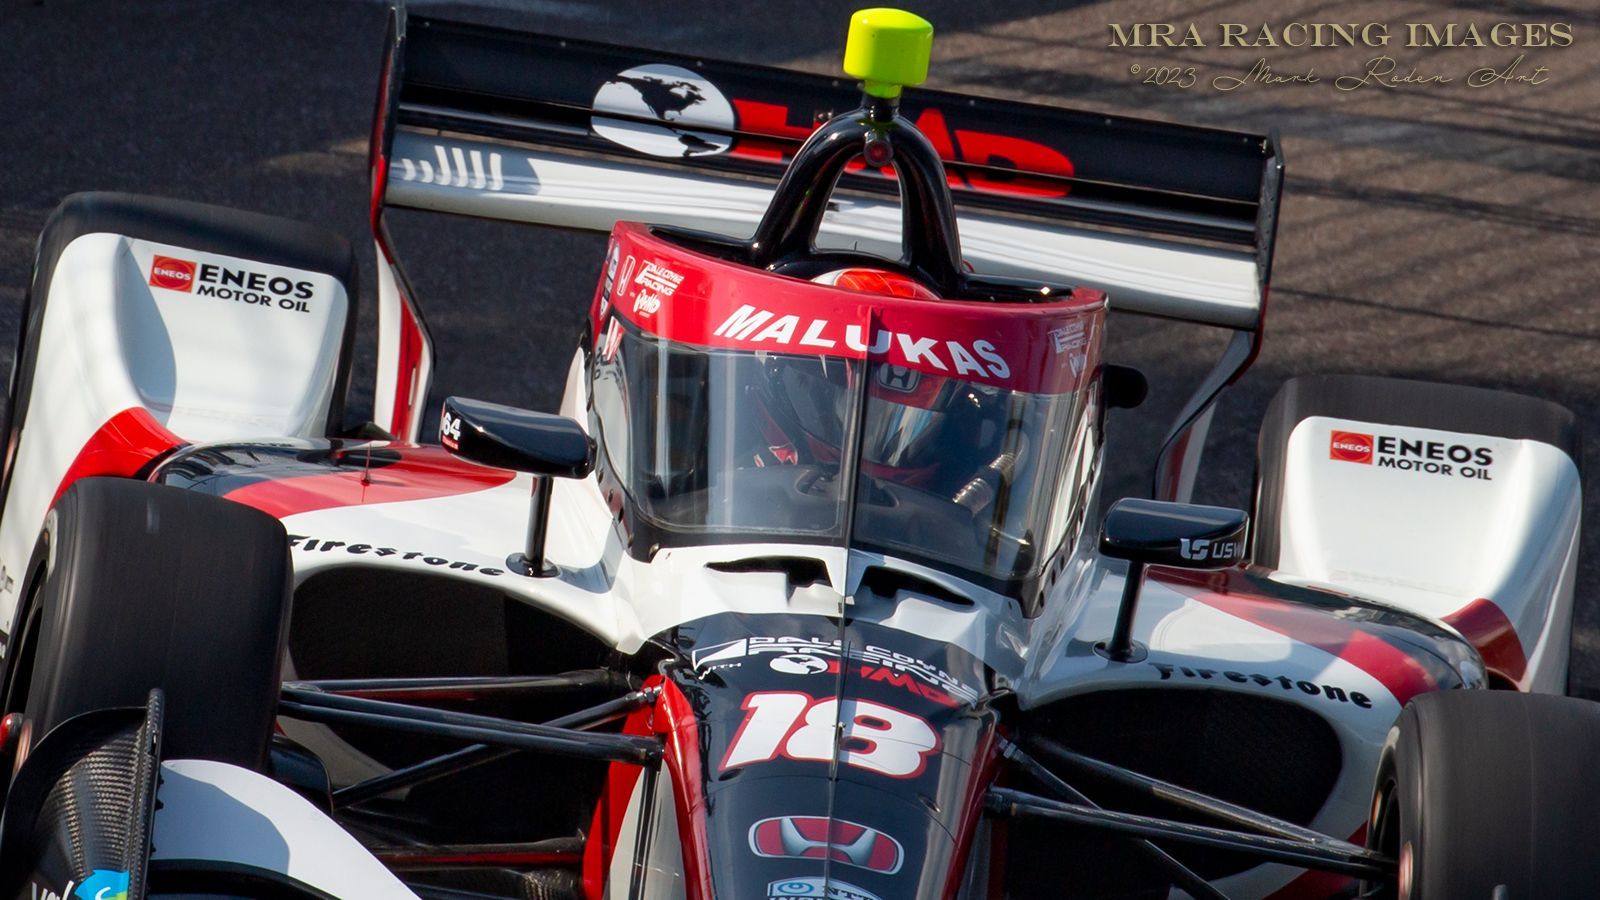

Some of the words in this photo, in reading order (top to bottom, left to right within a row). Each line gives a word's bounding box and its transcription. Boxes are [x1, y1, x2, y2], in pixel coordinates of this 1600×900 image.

[153, 266, 192, 281] ENEOS
[200, 263, 314, 300] ENEOS
[197, 285, 272, 307] MOTOR
[278, 298, 311, 313] OIL
[713, 303, 1011, 379] MALUKAS
[1333, 441, 1371, 453] ENEOS
[1378, 435, 1493, 466] ENEOS
[1378, 456, 1452, 476] MOTOR
[1460, 466, 1492, 481] OIL
[288, 534, 505, 576] Firestone
[1148, 662, 1373, 709] Firestone
[717, 690, 942, 780] 18
